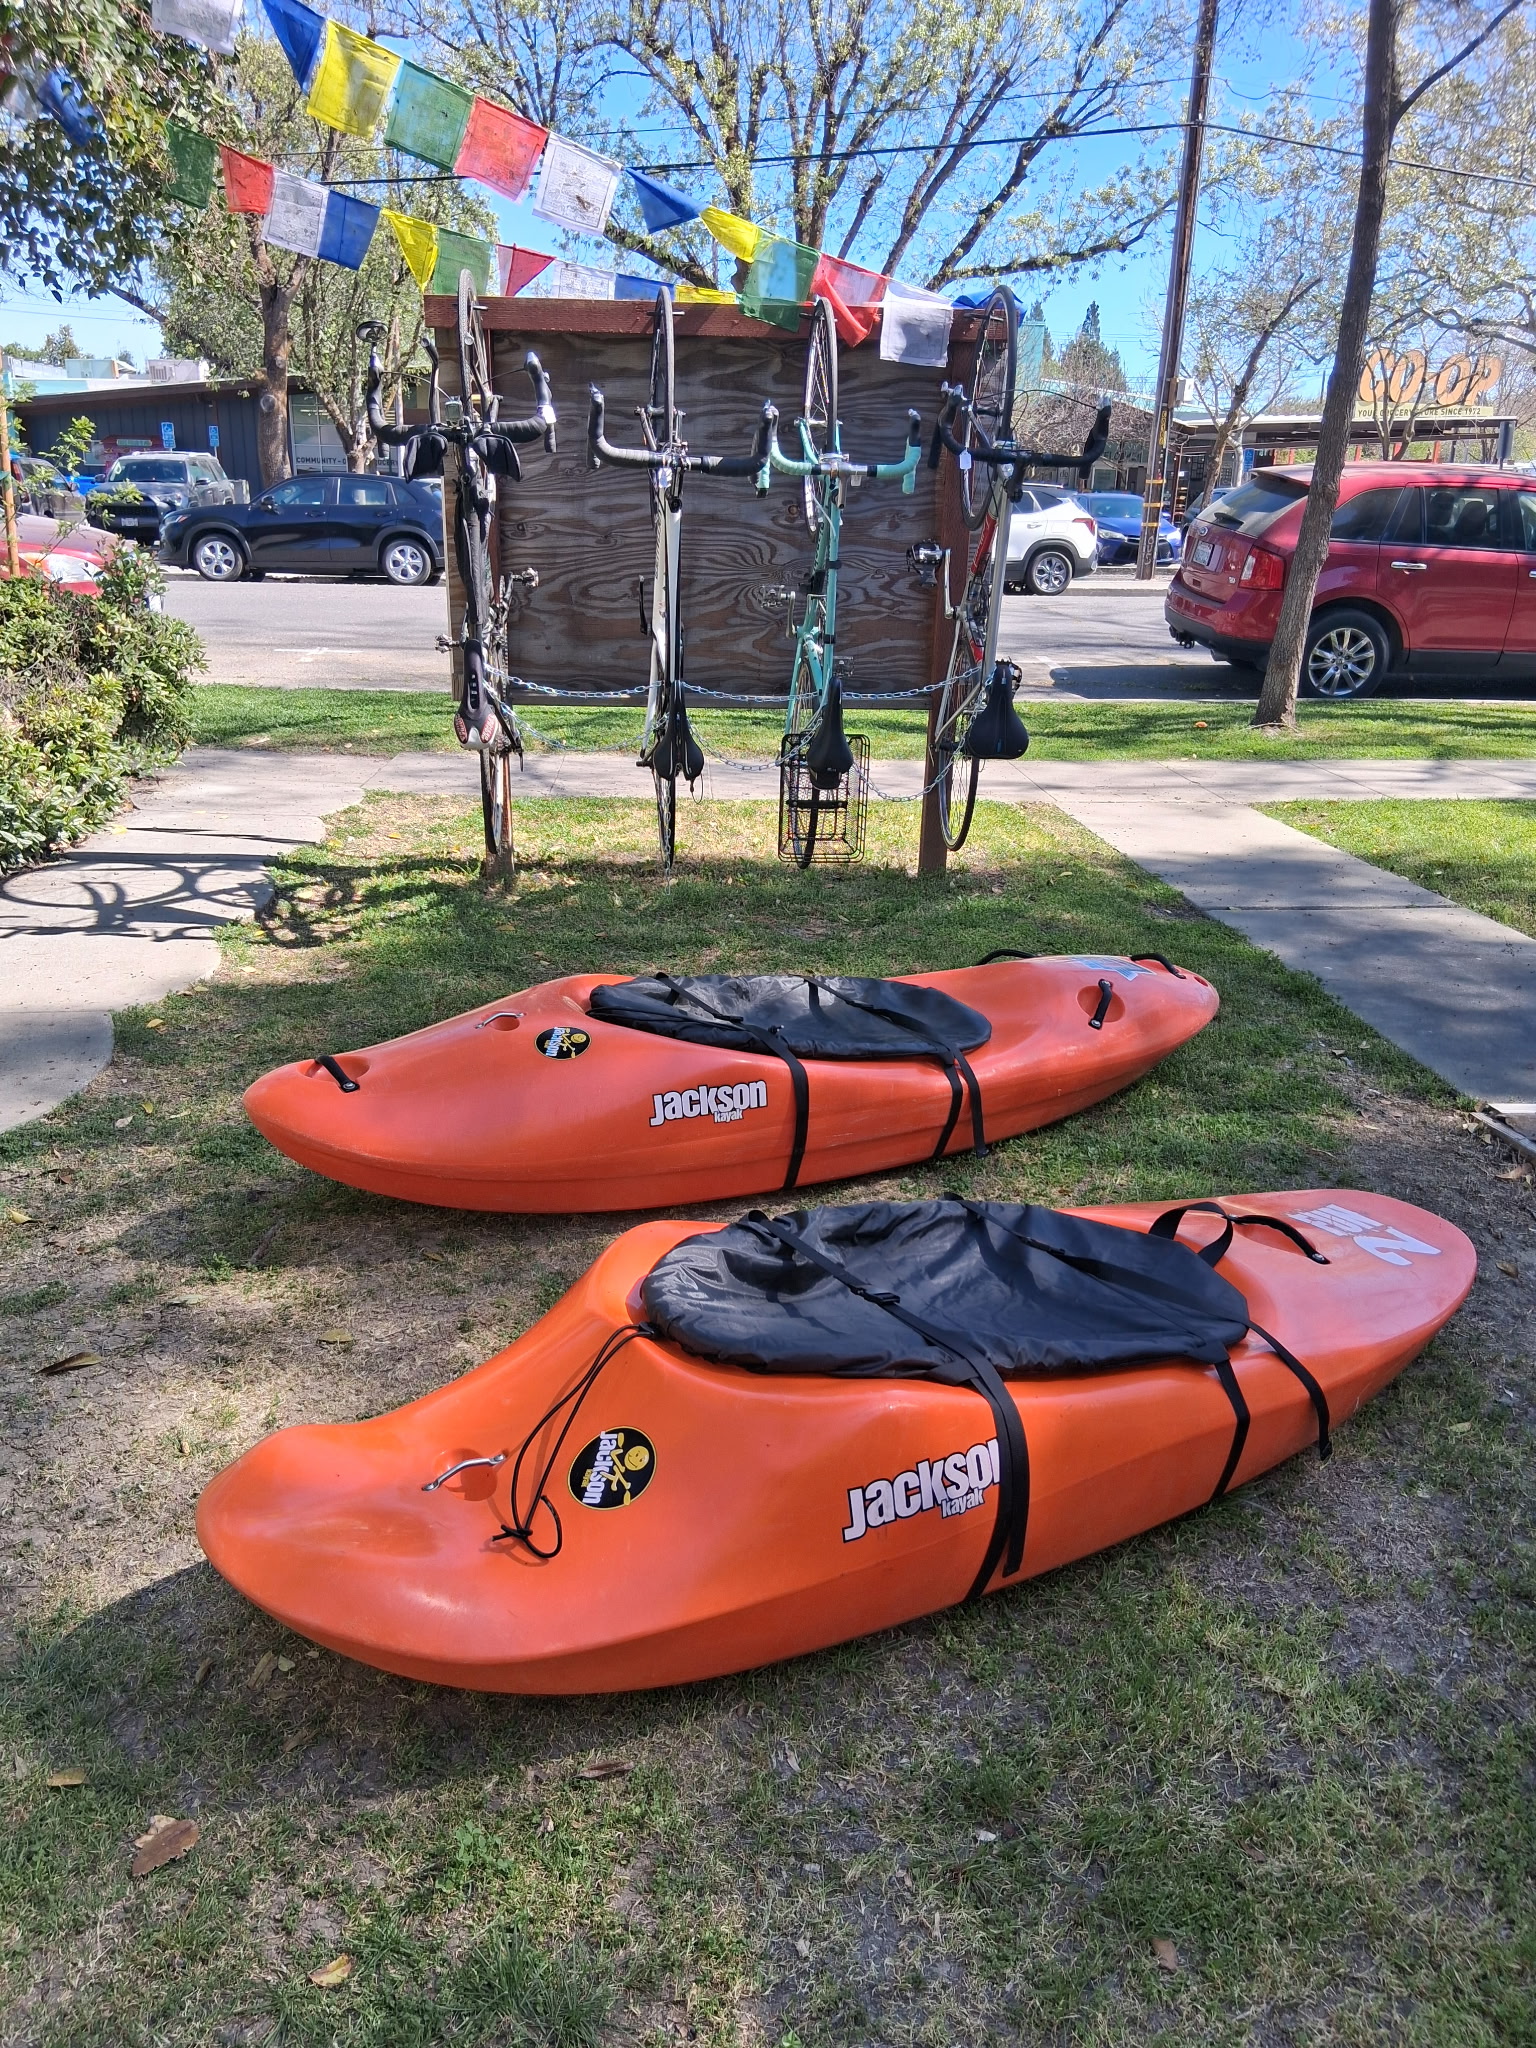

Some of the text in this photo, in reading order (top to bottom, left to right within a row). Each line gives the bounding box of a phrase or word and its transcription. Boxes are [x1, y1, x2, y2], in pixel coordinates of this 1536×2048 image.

[1359, 348, 1501, 406] CO-OP
[1440, 407, 1461, 416] SINCE
[296, 456, 337, 465] COMMUNITY
[713, 1107, 744, 1124] kayak
[941, 1486, 985, 1519] kayak
